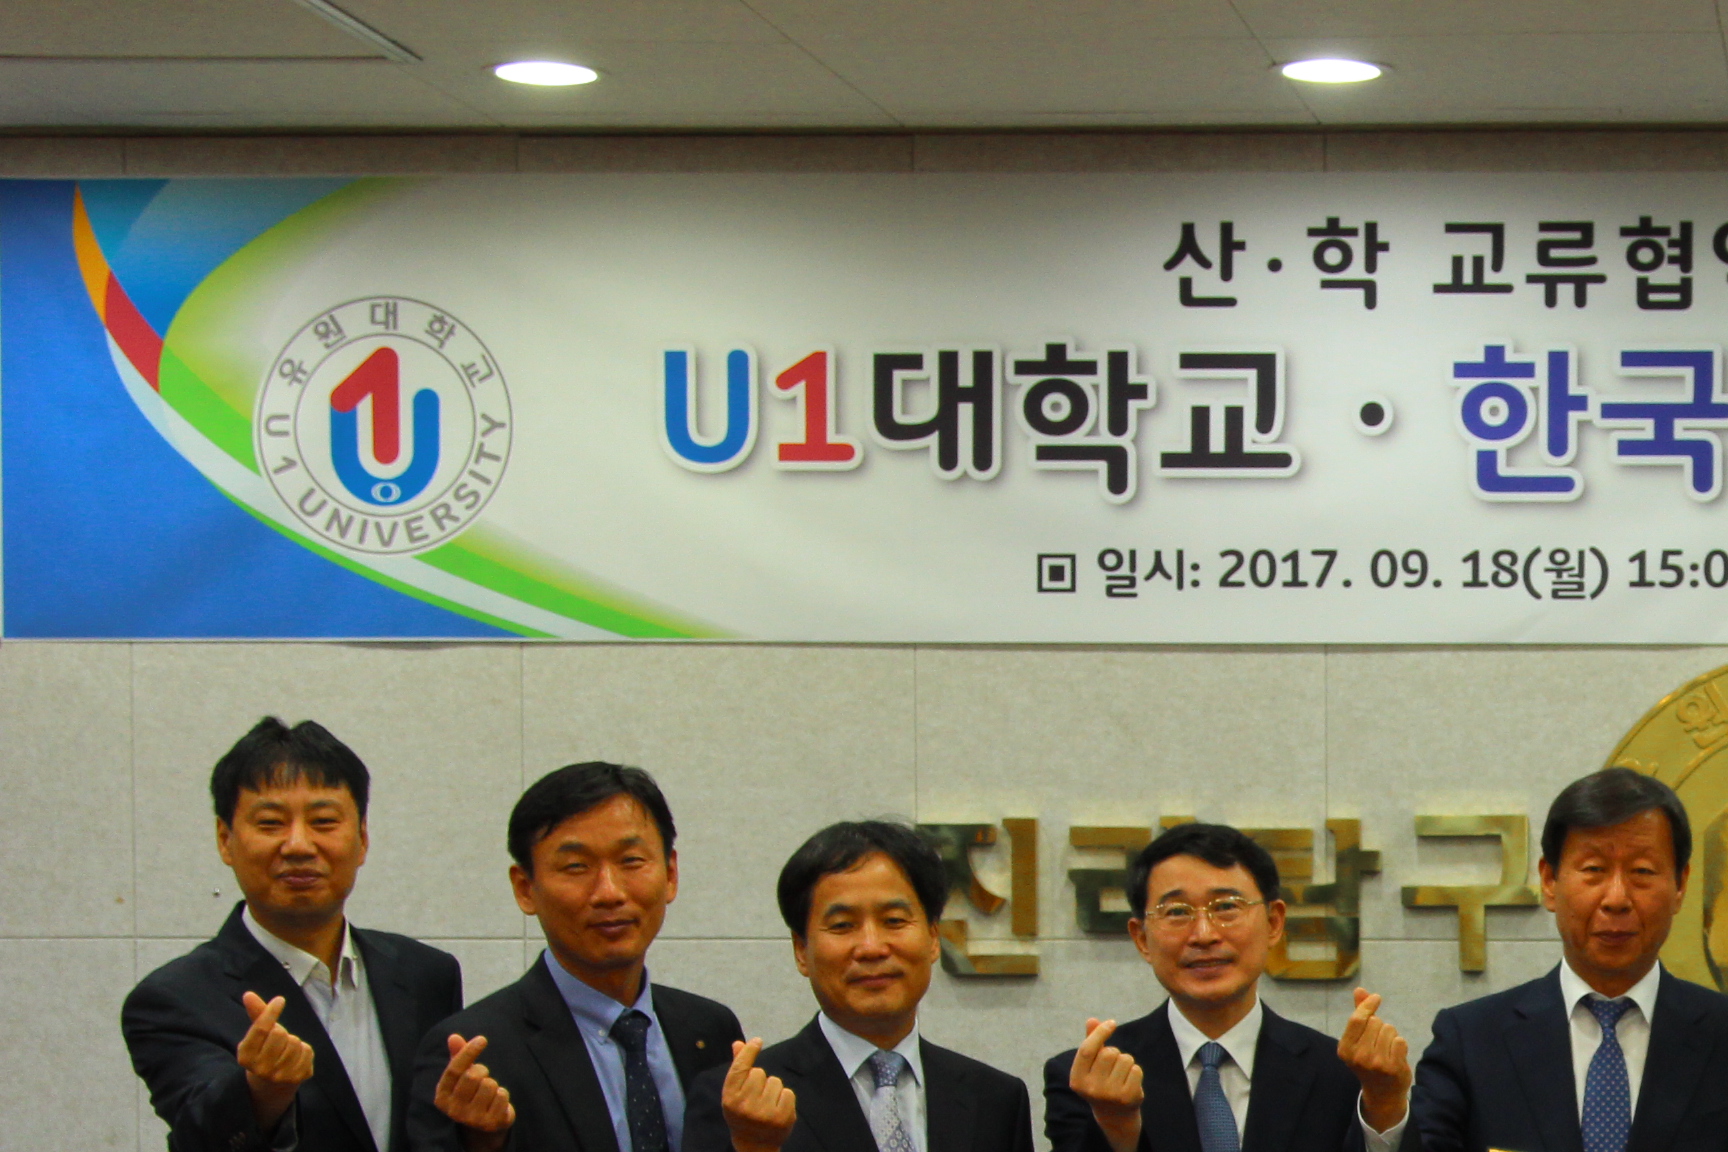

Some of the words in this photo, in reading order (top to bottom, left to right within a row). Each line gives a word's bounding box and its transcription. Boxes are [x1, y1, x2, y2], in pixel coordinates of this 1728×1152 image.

[1164, 218, 1390, 310] 산·학
[277, 301, 496, 389] 유원대학교
[666, 344, 1292, 495] U1대학교
[296, 411, 507, 548] UNIVERSITY
[1099, 550, 1200, 598] 일시:
[1221, 551, 1352, 588] 2017.
[1372, 551, 1442, 588] 09.
[1464, 549, 1609, 600] 18(월)
